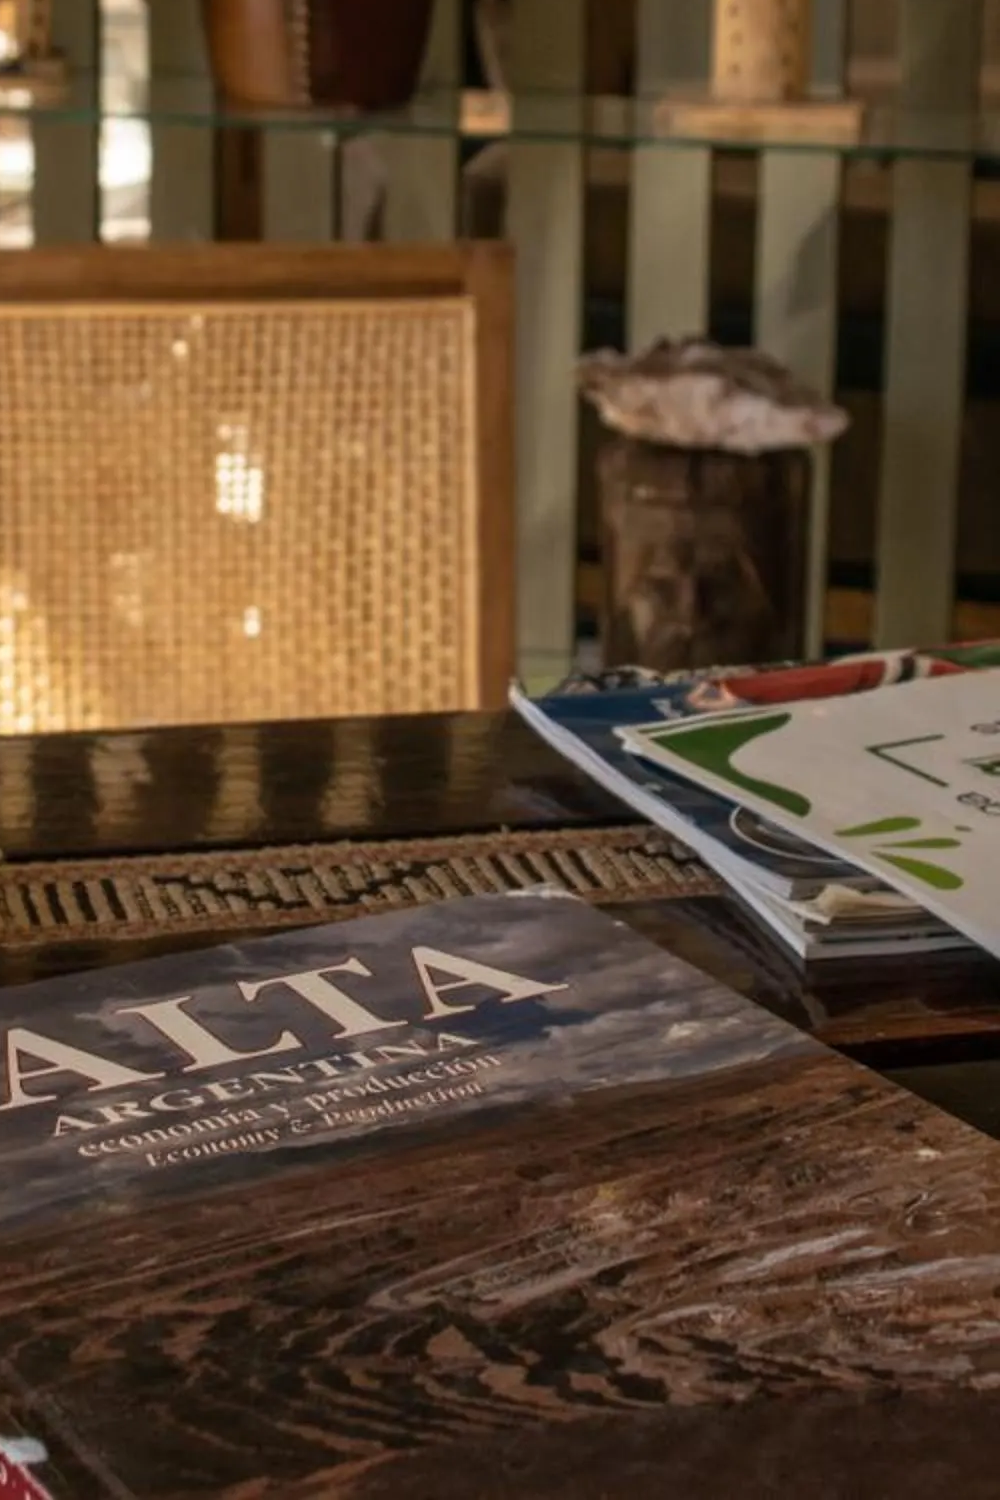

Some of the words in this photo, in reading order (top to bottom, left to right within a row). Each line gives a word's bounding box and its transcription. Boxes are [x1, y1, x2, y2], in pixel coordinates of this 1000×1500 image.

[53, 1032, 481, 1137] ARGENTINA
[77, 1107, 264, 1157] economía
[268, 1099, 291, 1120] y
[302, 1053, 501, 1112] producción
[145, 1126, 282, 1167] Economy
[320, 1079, 484, 1127] Production
